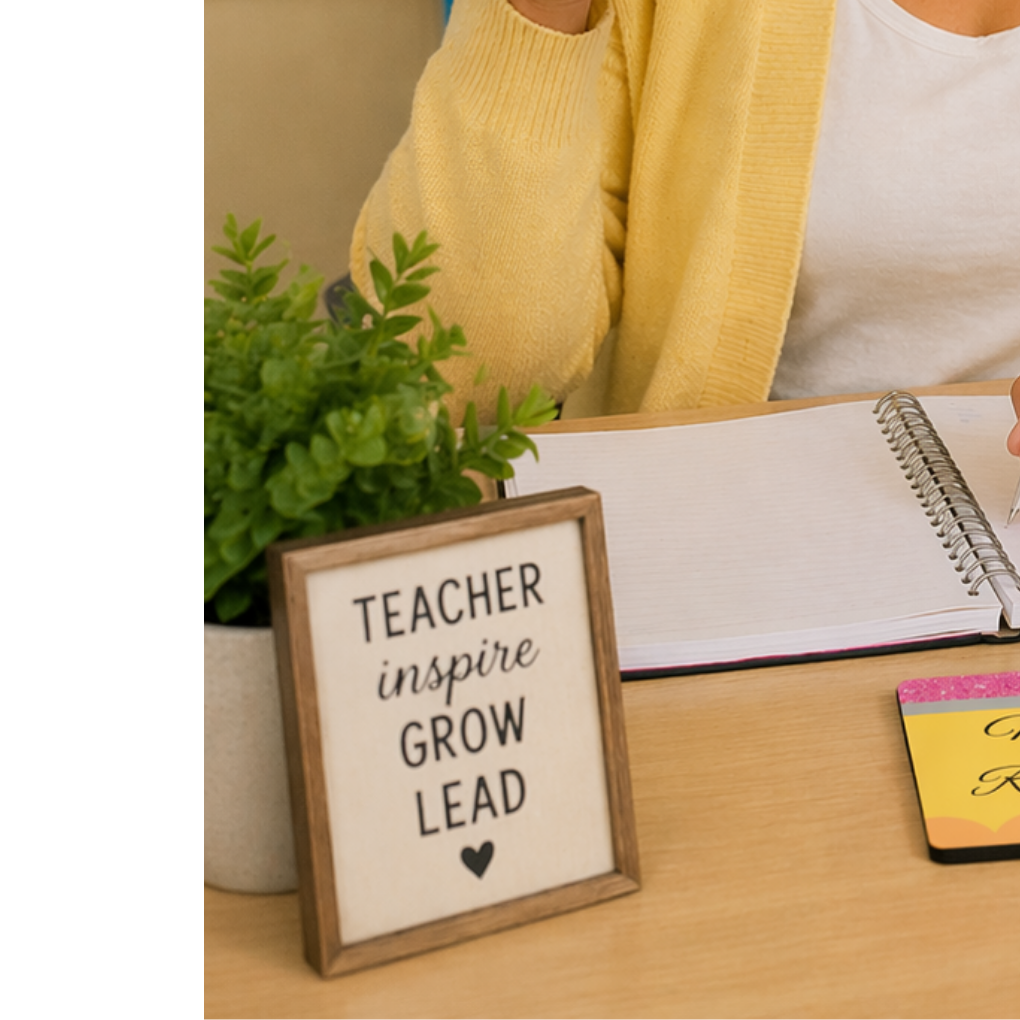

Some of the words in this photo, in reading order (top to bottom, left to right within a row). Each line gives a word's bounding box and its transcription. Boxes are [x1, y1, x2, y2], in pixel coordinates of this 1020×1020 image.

[352, 561, 545, 644] TEACHER
[376, 636, 541, 706] inspire
[399, 696, 527, 770] GROW
[415, 767, 528, 837] LEAD
